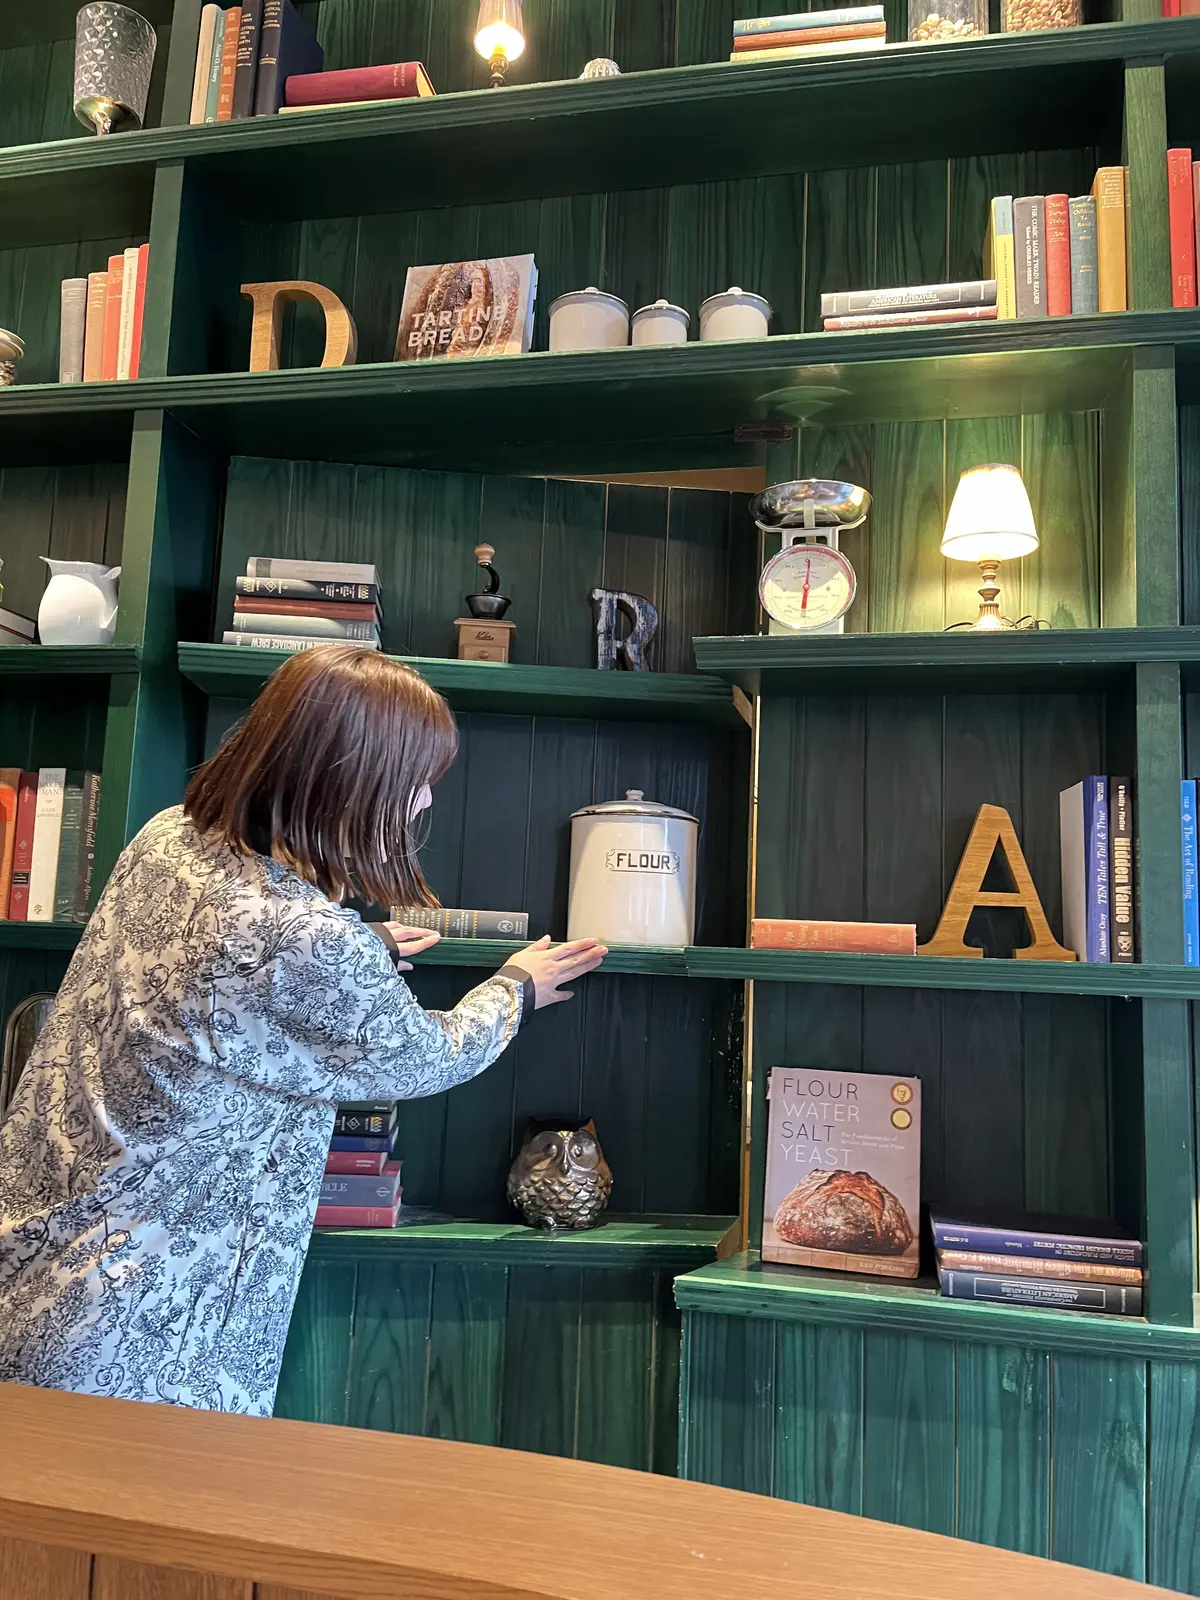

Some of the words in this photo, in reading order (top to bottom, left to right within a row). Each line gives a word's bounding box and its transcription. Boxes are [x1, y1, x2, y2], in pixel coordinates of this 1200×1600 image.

[1031, 218, 1039, 239] COMIC
[241, 281, 357, 373] D
[411, 306, 505, 329] TARTINE
[408, 326, 484, 348] BREAD
[591, 588, 659, 673] R
[250, 637, 271, 648] GREW
[45, 773, 59, 781] THE
[41, 788, 59, 796] MAN
[85, 810, 98, 848] Mansfield
[1096, 810, 1106, 830] True
[1183, 825, 1194, 841] The
[1096, 841, 1106, 859] Tall
[1184, 842, 1194, 856] Act
[616, 853, 671, 870] FLOUR
[1096, 859, 1107, 883] Tales
[1114, 837, 1131, 884] Hidden
[917, 803, 1076, 962] A
[1183, 867, 1195, 900] Reading
[1097, 884, 1107, 905] TEN
[1115, 885, 1132, 923] Value
[782, 1077, 859, 1100] FLOUR
[782, 1099, 860, 1123] WATER
[781, 1121, 836, 1142] SALT
[780, 1143, 853, 1167] YEAST
[1001, 1286, 1042, 1297] LITERATURE
[1042, 1292, 1079, 1300] AMERICAN
